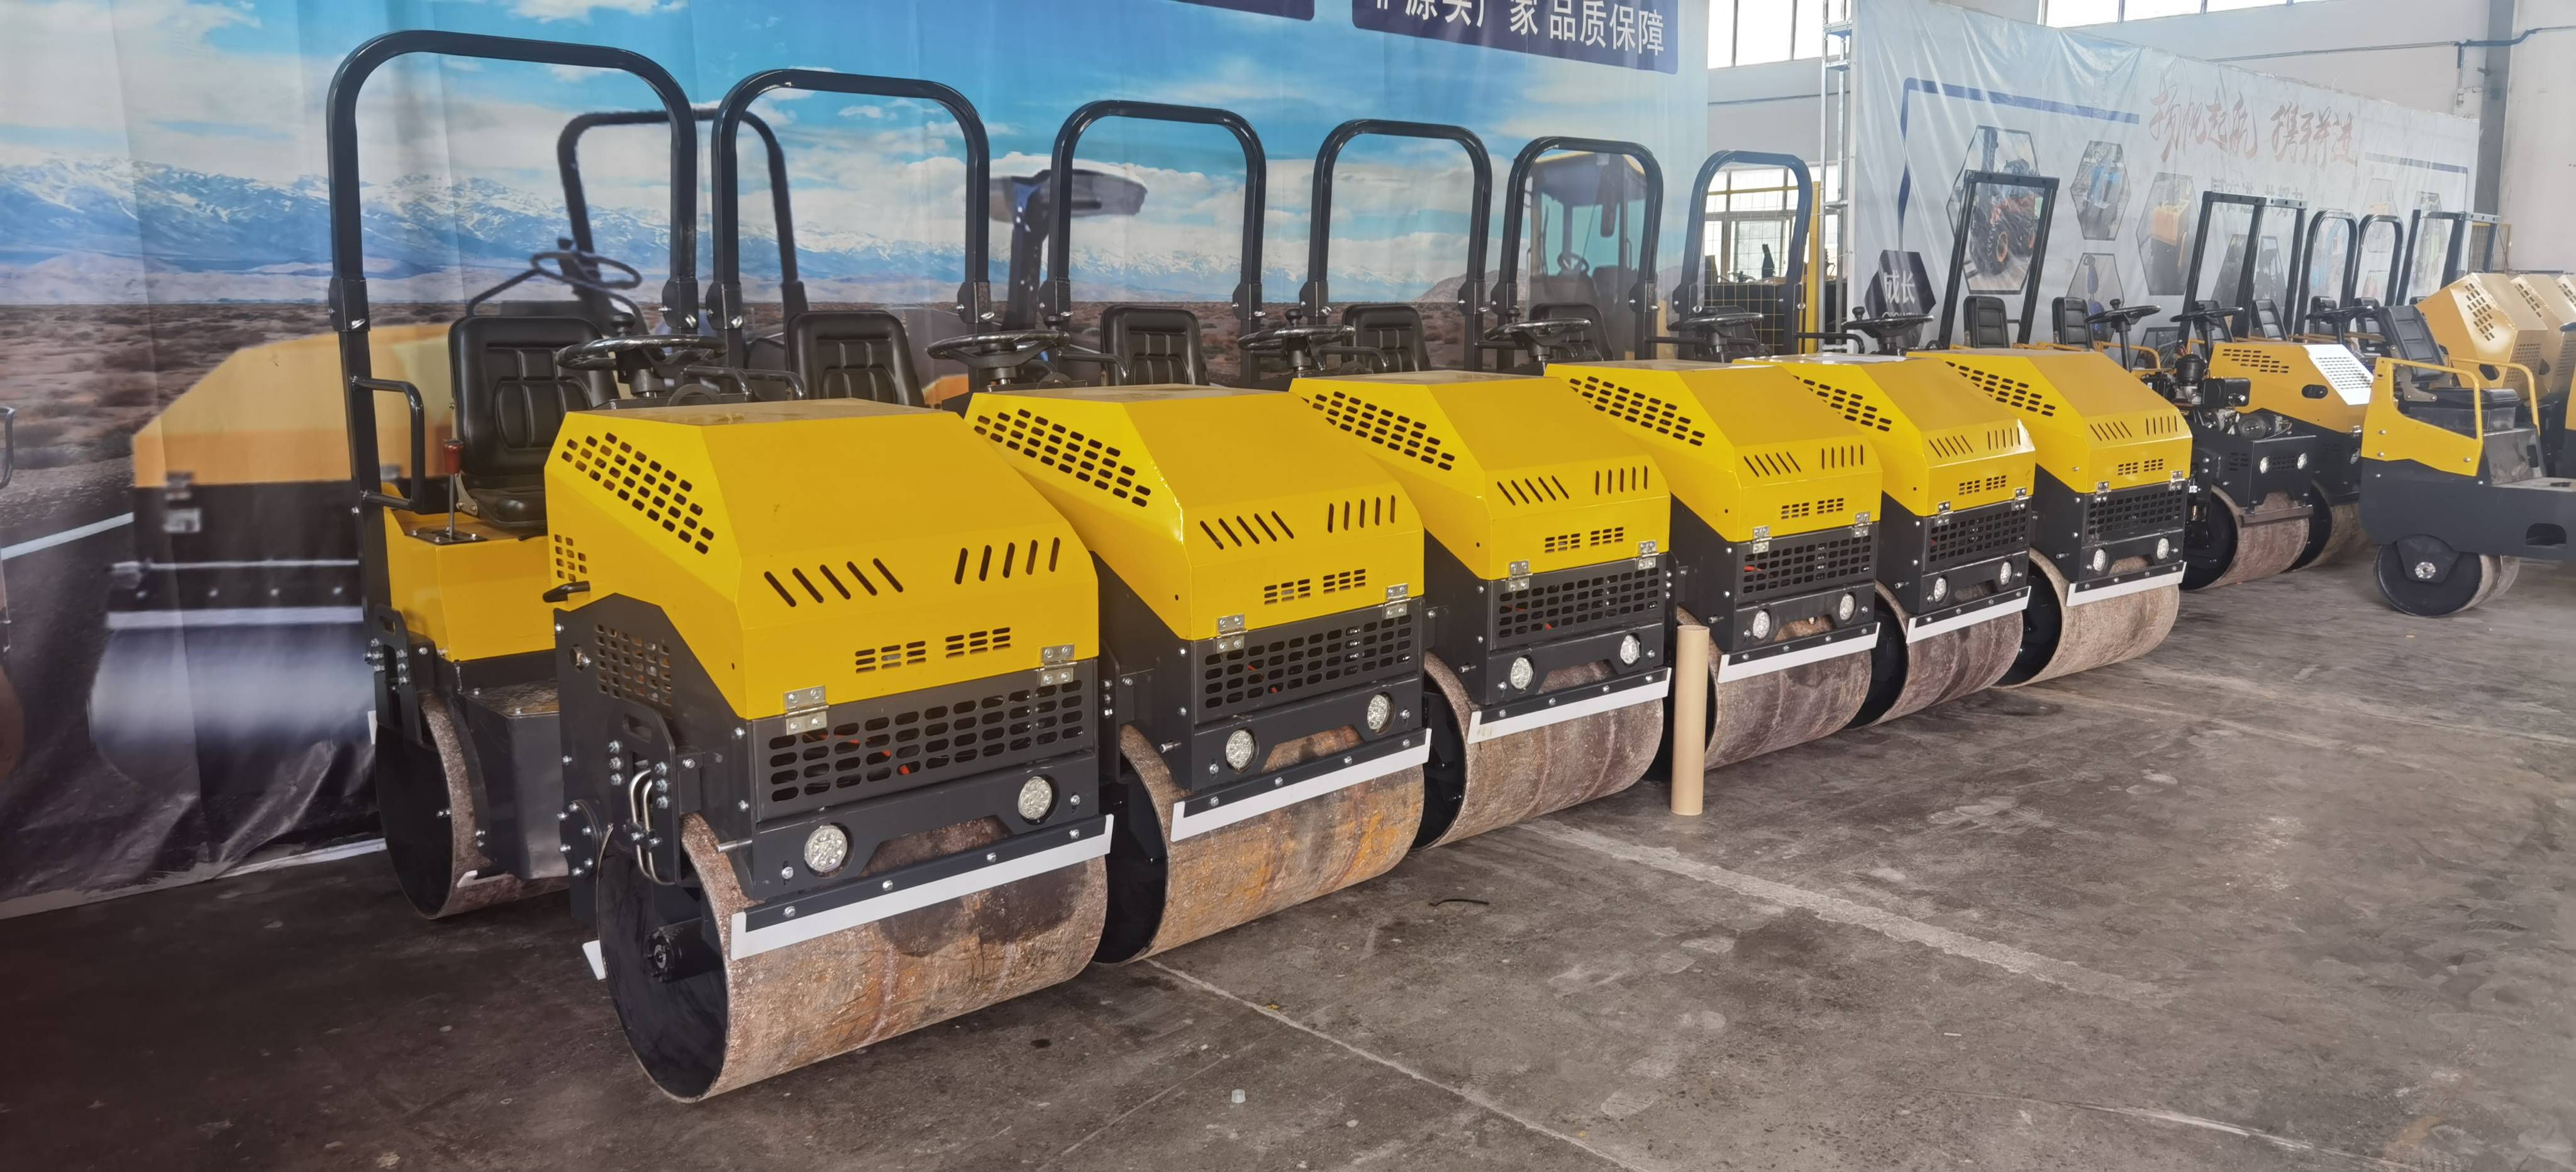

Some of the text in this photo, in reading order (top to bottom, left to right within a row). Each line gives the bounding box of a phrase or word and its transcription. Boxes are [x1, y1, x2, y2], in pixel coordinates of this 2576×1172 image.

[1550, 0, 1664, 56] 品质保障
[1884, 268, 1916, 304] 成长
